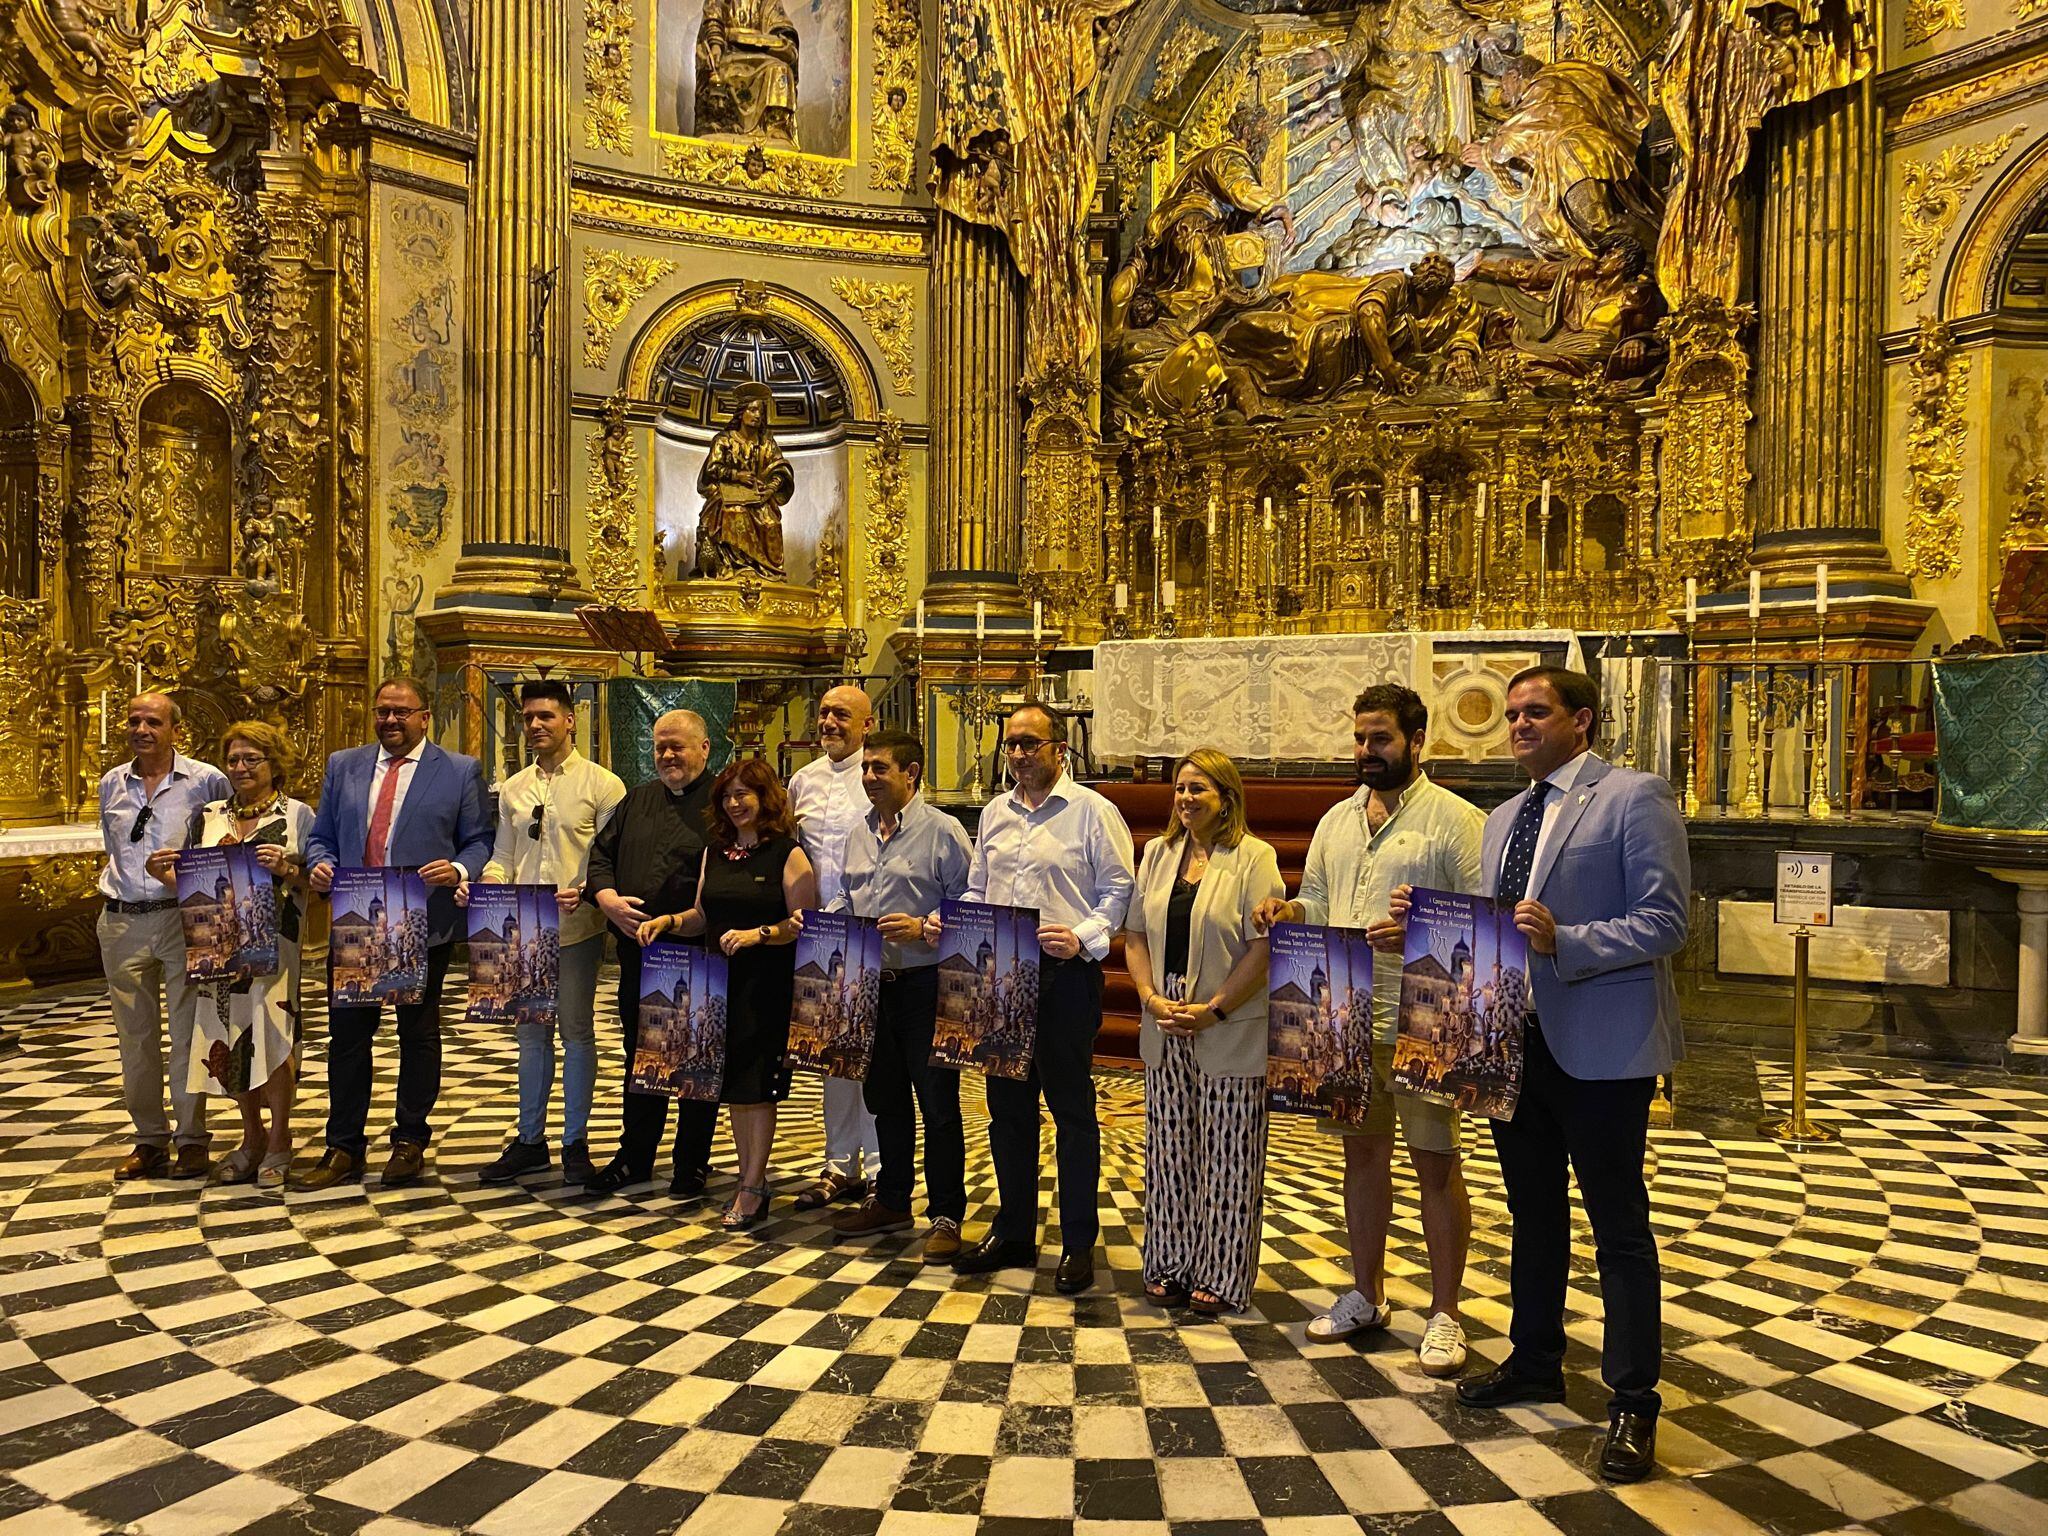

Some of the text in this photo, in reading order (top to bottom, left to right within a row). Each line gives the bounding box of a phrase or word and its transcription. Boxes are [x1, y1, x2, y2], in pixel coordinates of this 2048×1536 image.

[1433, 897, 1450, 907] Congreso
[1453, 901, 1470, 909] Nacional
[1419, 905, 1434, 914] Semana
[1436, 907, 1448, 916] Santa
[1454, 911, 1472, 920] Ciudades
